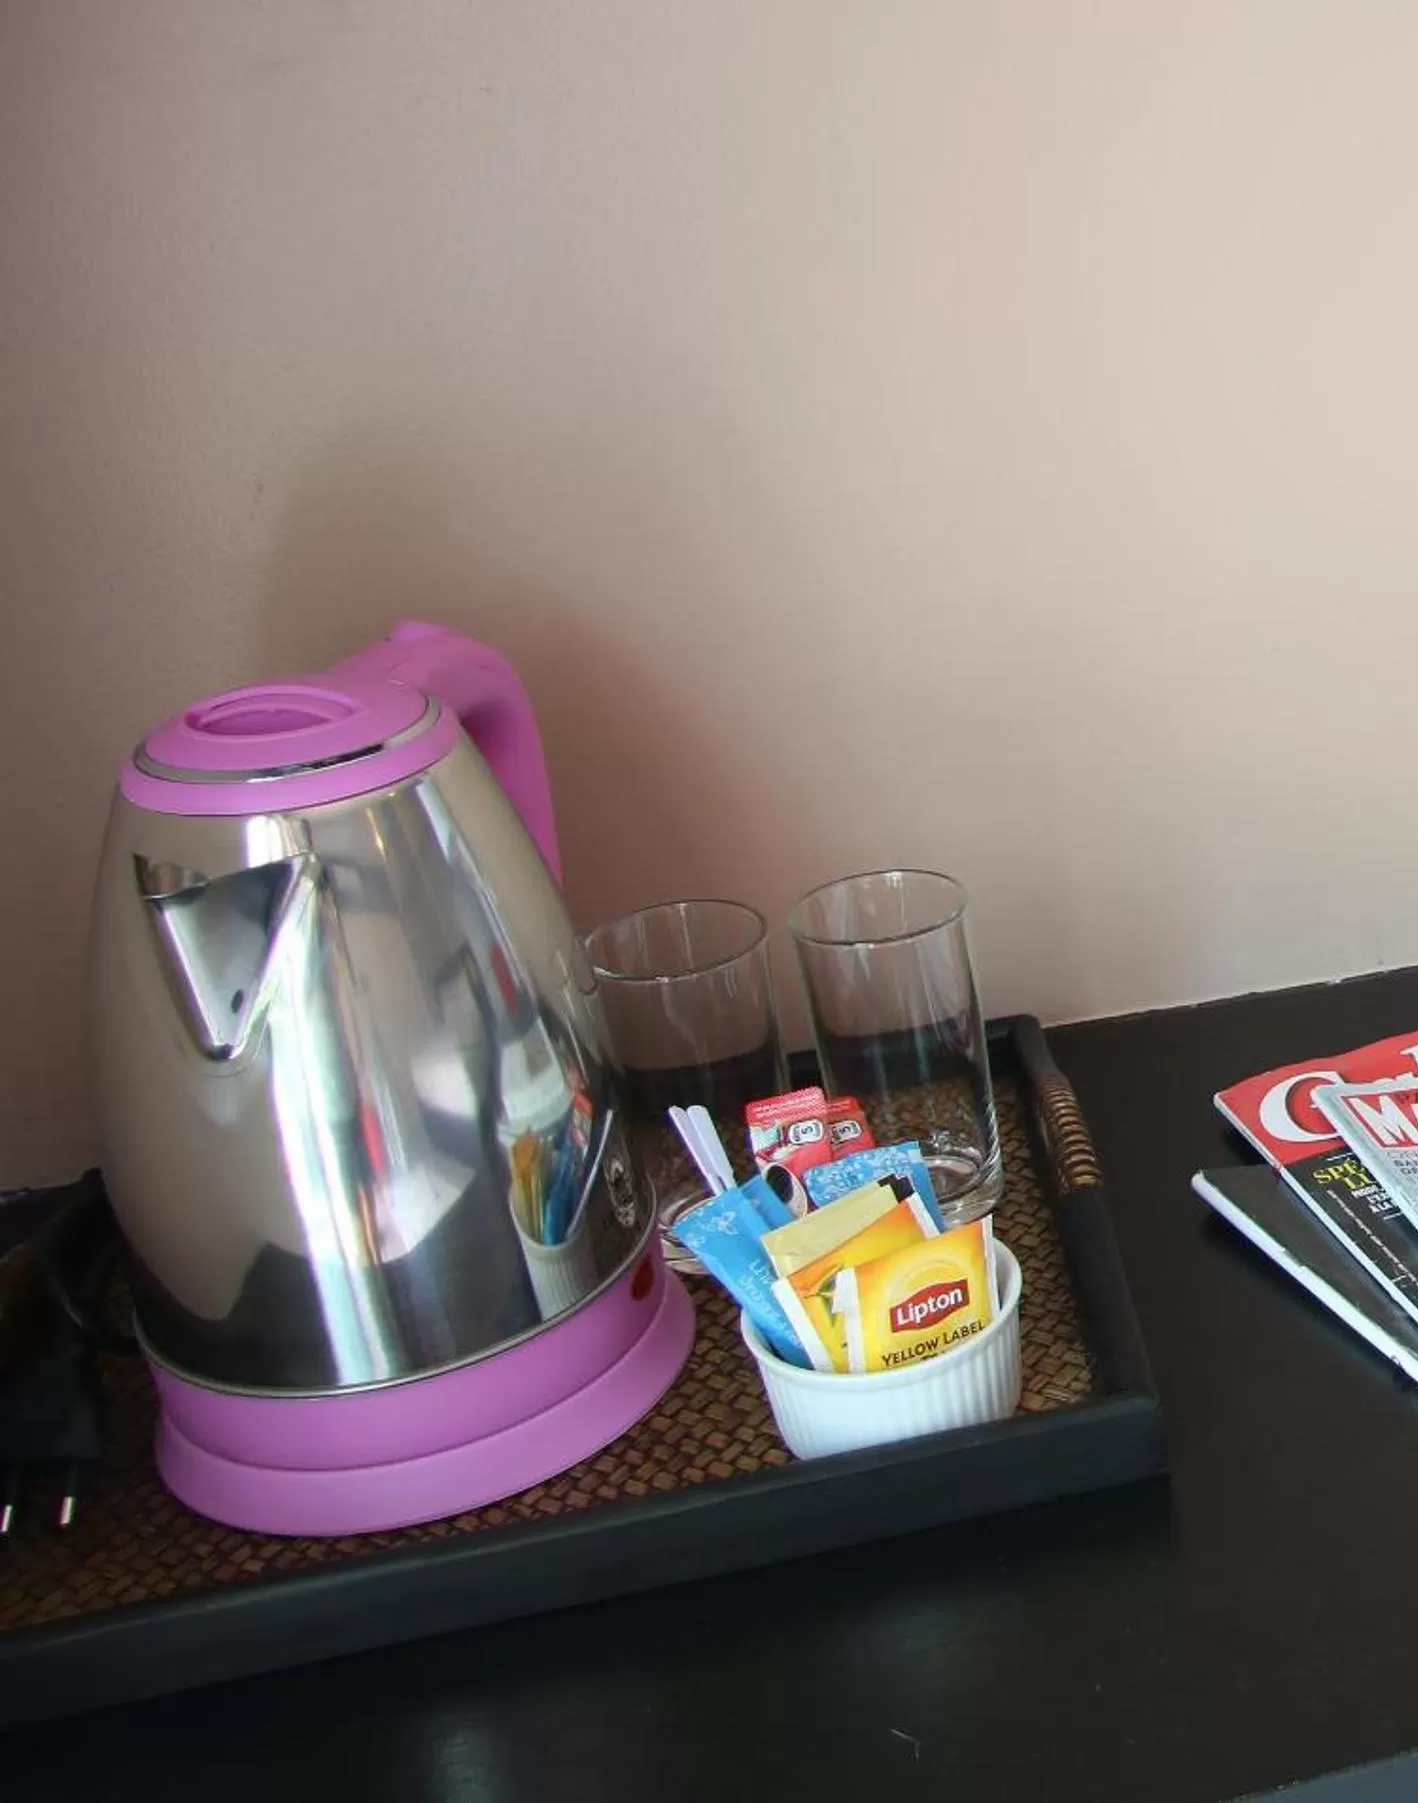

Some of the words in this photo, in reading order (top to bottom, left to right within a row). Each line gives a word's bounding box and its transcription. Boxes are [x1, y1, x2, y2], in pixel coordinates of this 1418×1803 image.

[895, 1286, 965, 1327] Lipton
[881, 1337, 940, 1367] YELLOW
[943, 1321, 986, 1347] LABEL
